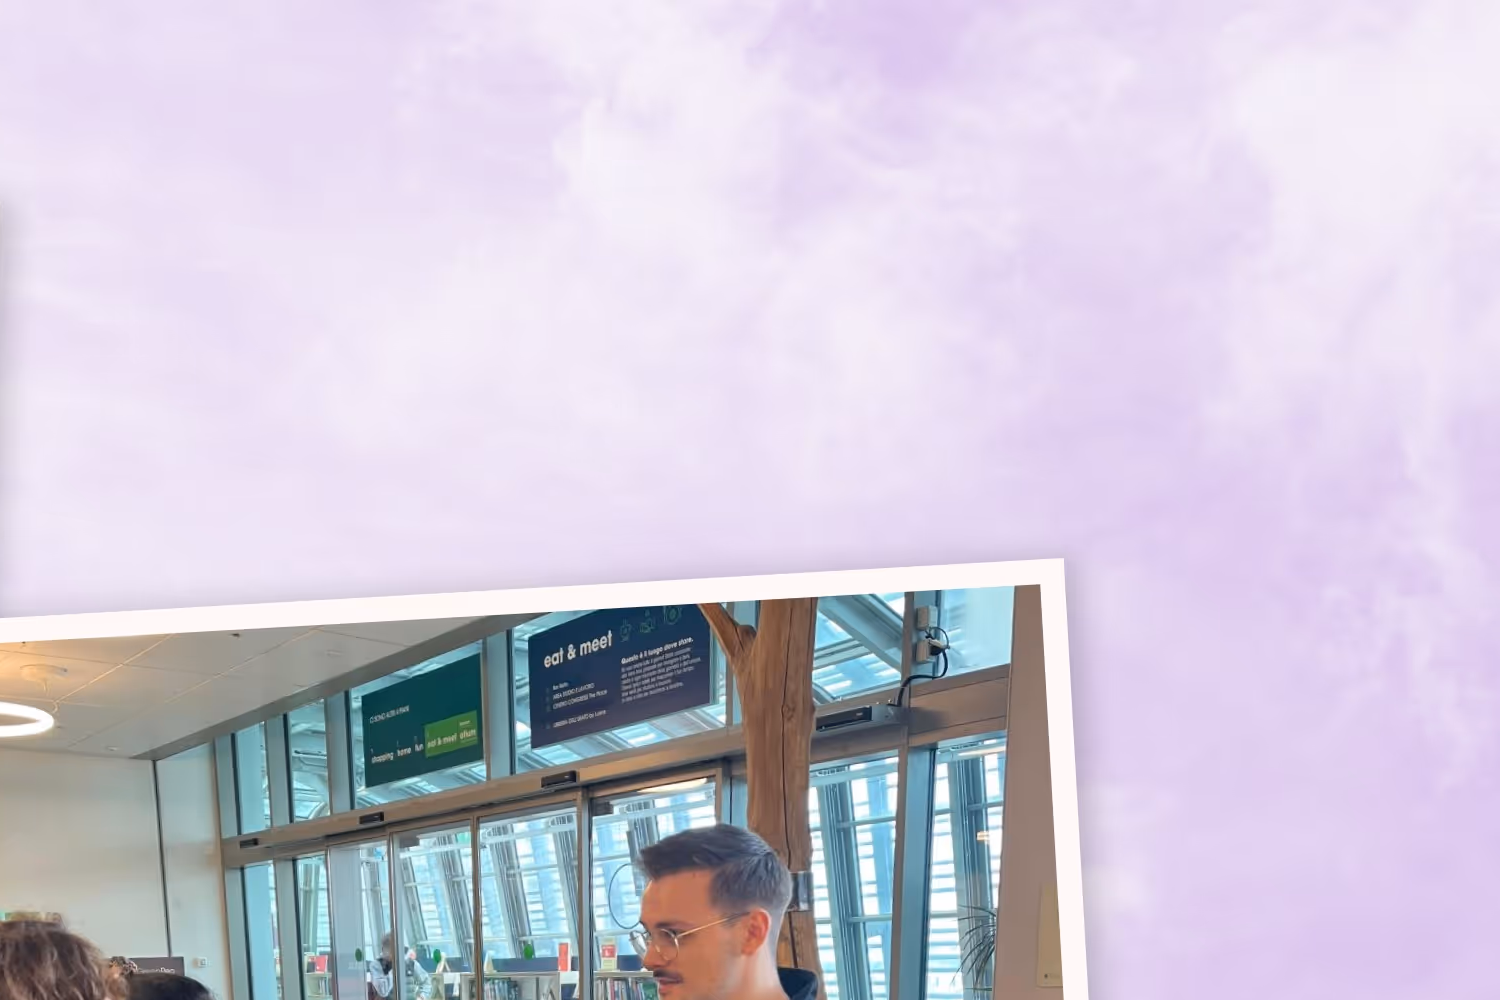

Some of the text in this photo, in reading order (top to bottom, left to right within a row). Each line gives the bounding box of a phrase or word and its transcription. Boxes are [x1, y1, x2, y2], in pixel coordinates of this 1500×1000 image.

[544, 630, 612, 668] eat & meet
